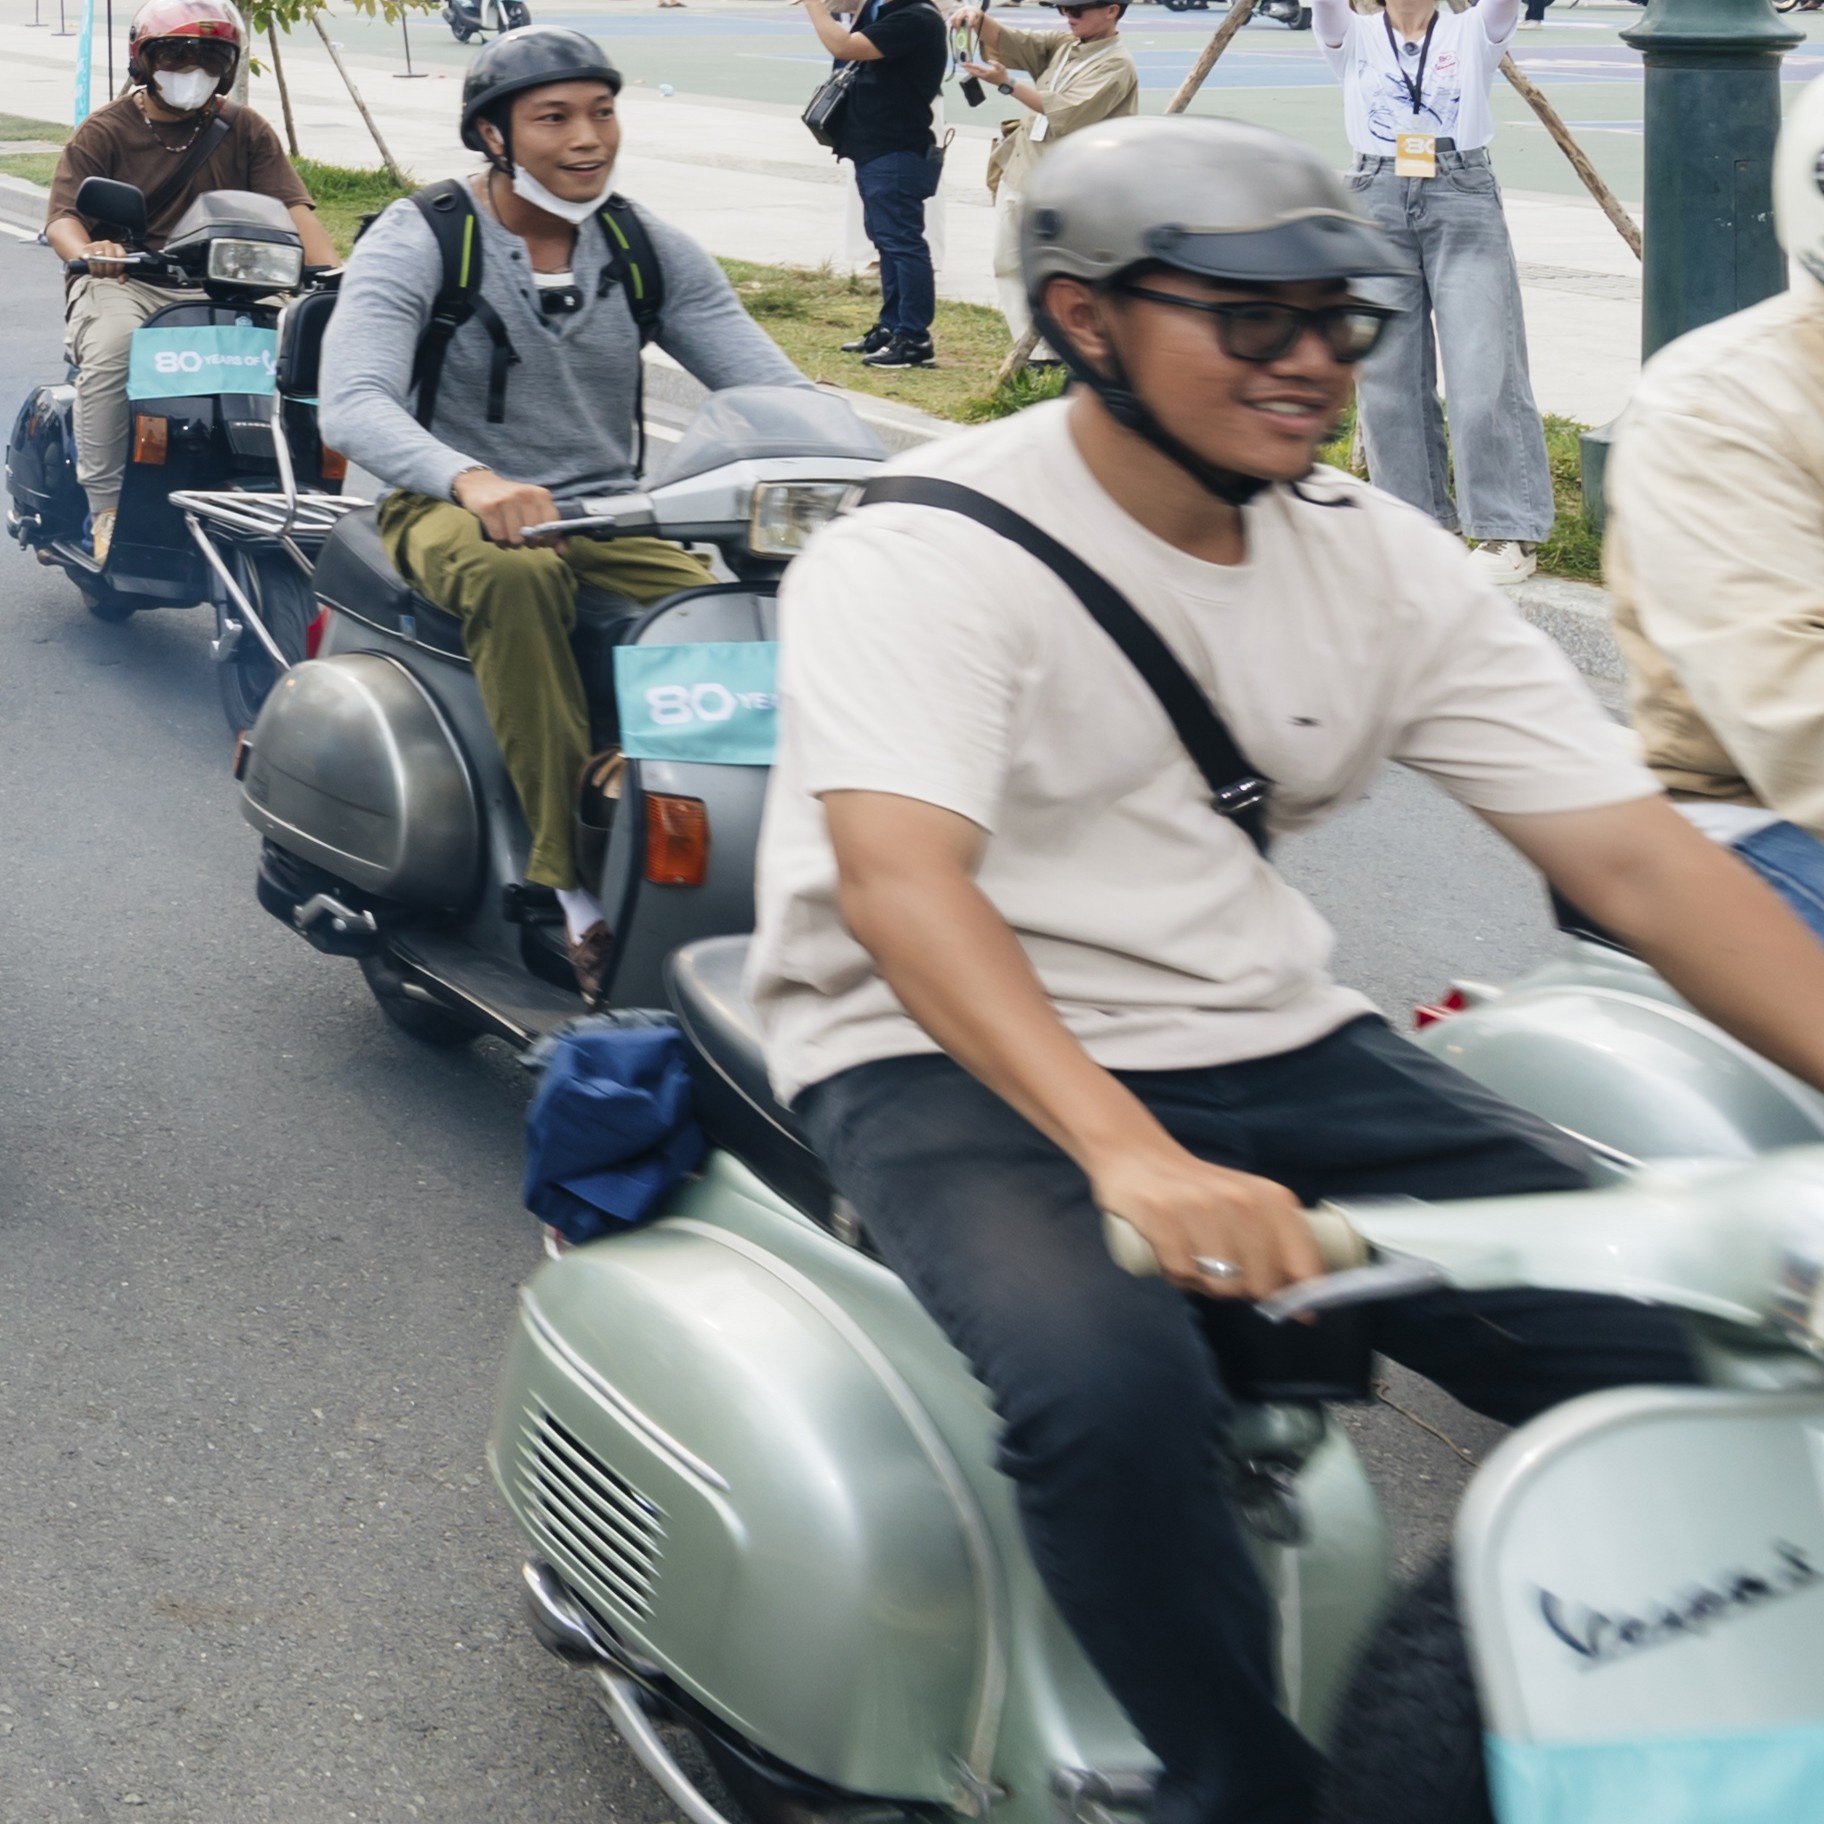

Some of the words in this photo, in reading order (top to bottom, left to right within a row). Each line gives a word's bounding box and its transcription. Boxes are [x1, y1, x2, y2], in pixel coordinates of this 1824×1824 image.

[154, 351, 202, 373] 80
[203, 354, 242, 366] YEARS
[244, 354, 261, 366] OF
[646, 683, 736, 725] 80
